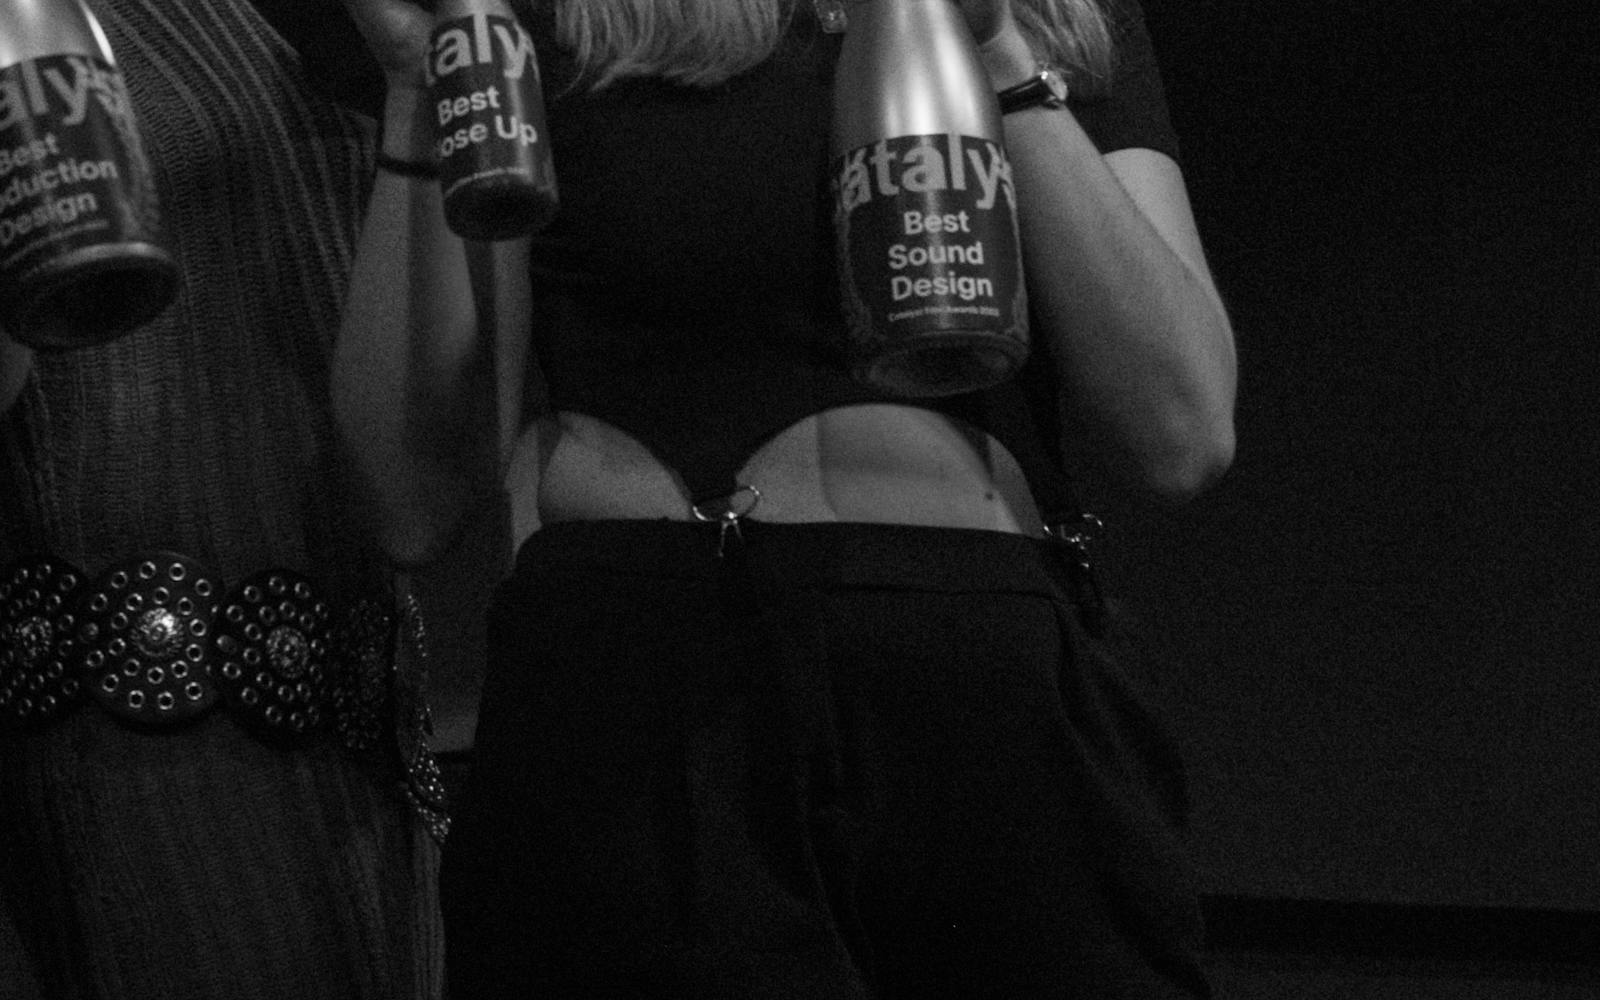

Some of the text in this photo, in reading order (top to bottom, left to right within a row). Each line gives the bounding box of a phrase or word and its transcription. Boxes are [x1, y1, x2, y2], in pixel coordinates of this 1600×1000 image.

[437, 85, 501, 127] Best
[439, 114, 538, 158] ose Up
[903, 209, 971, 235] Best
[887, 240, 985, 270] Sound
[891, 271, 994, 301] Design
